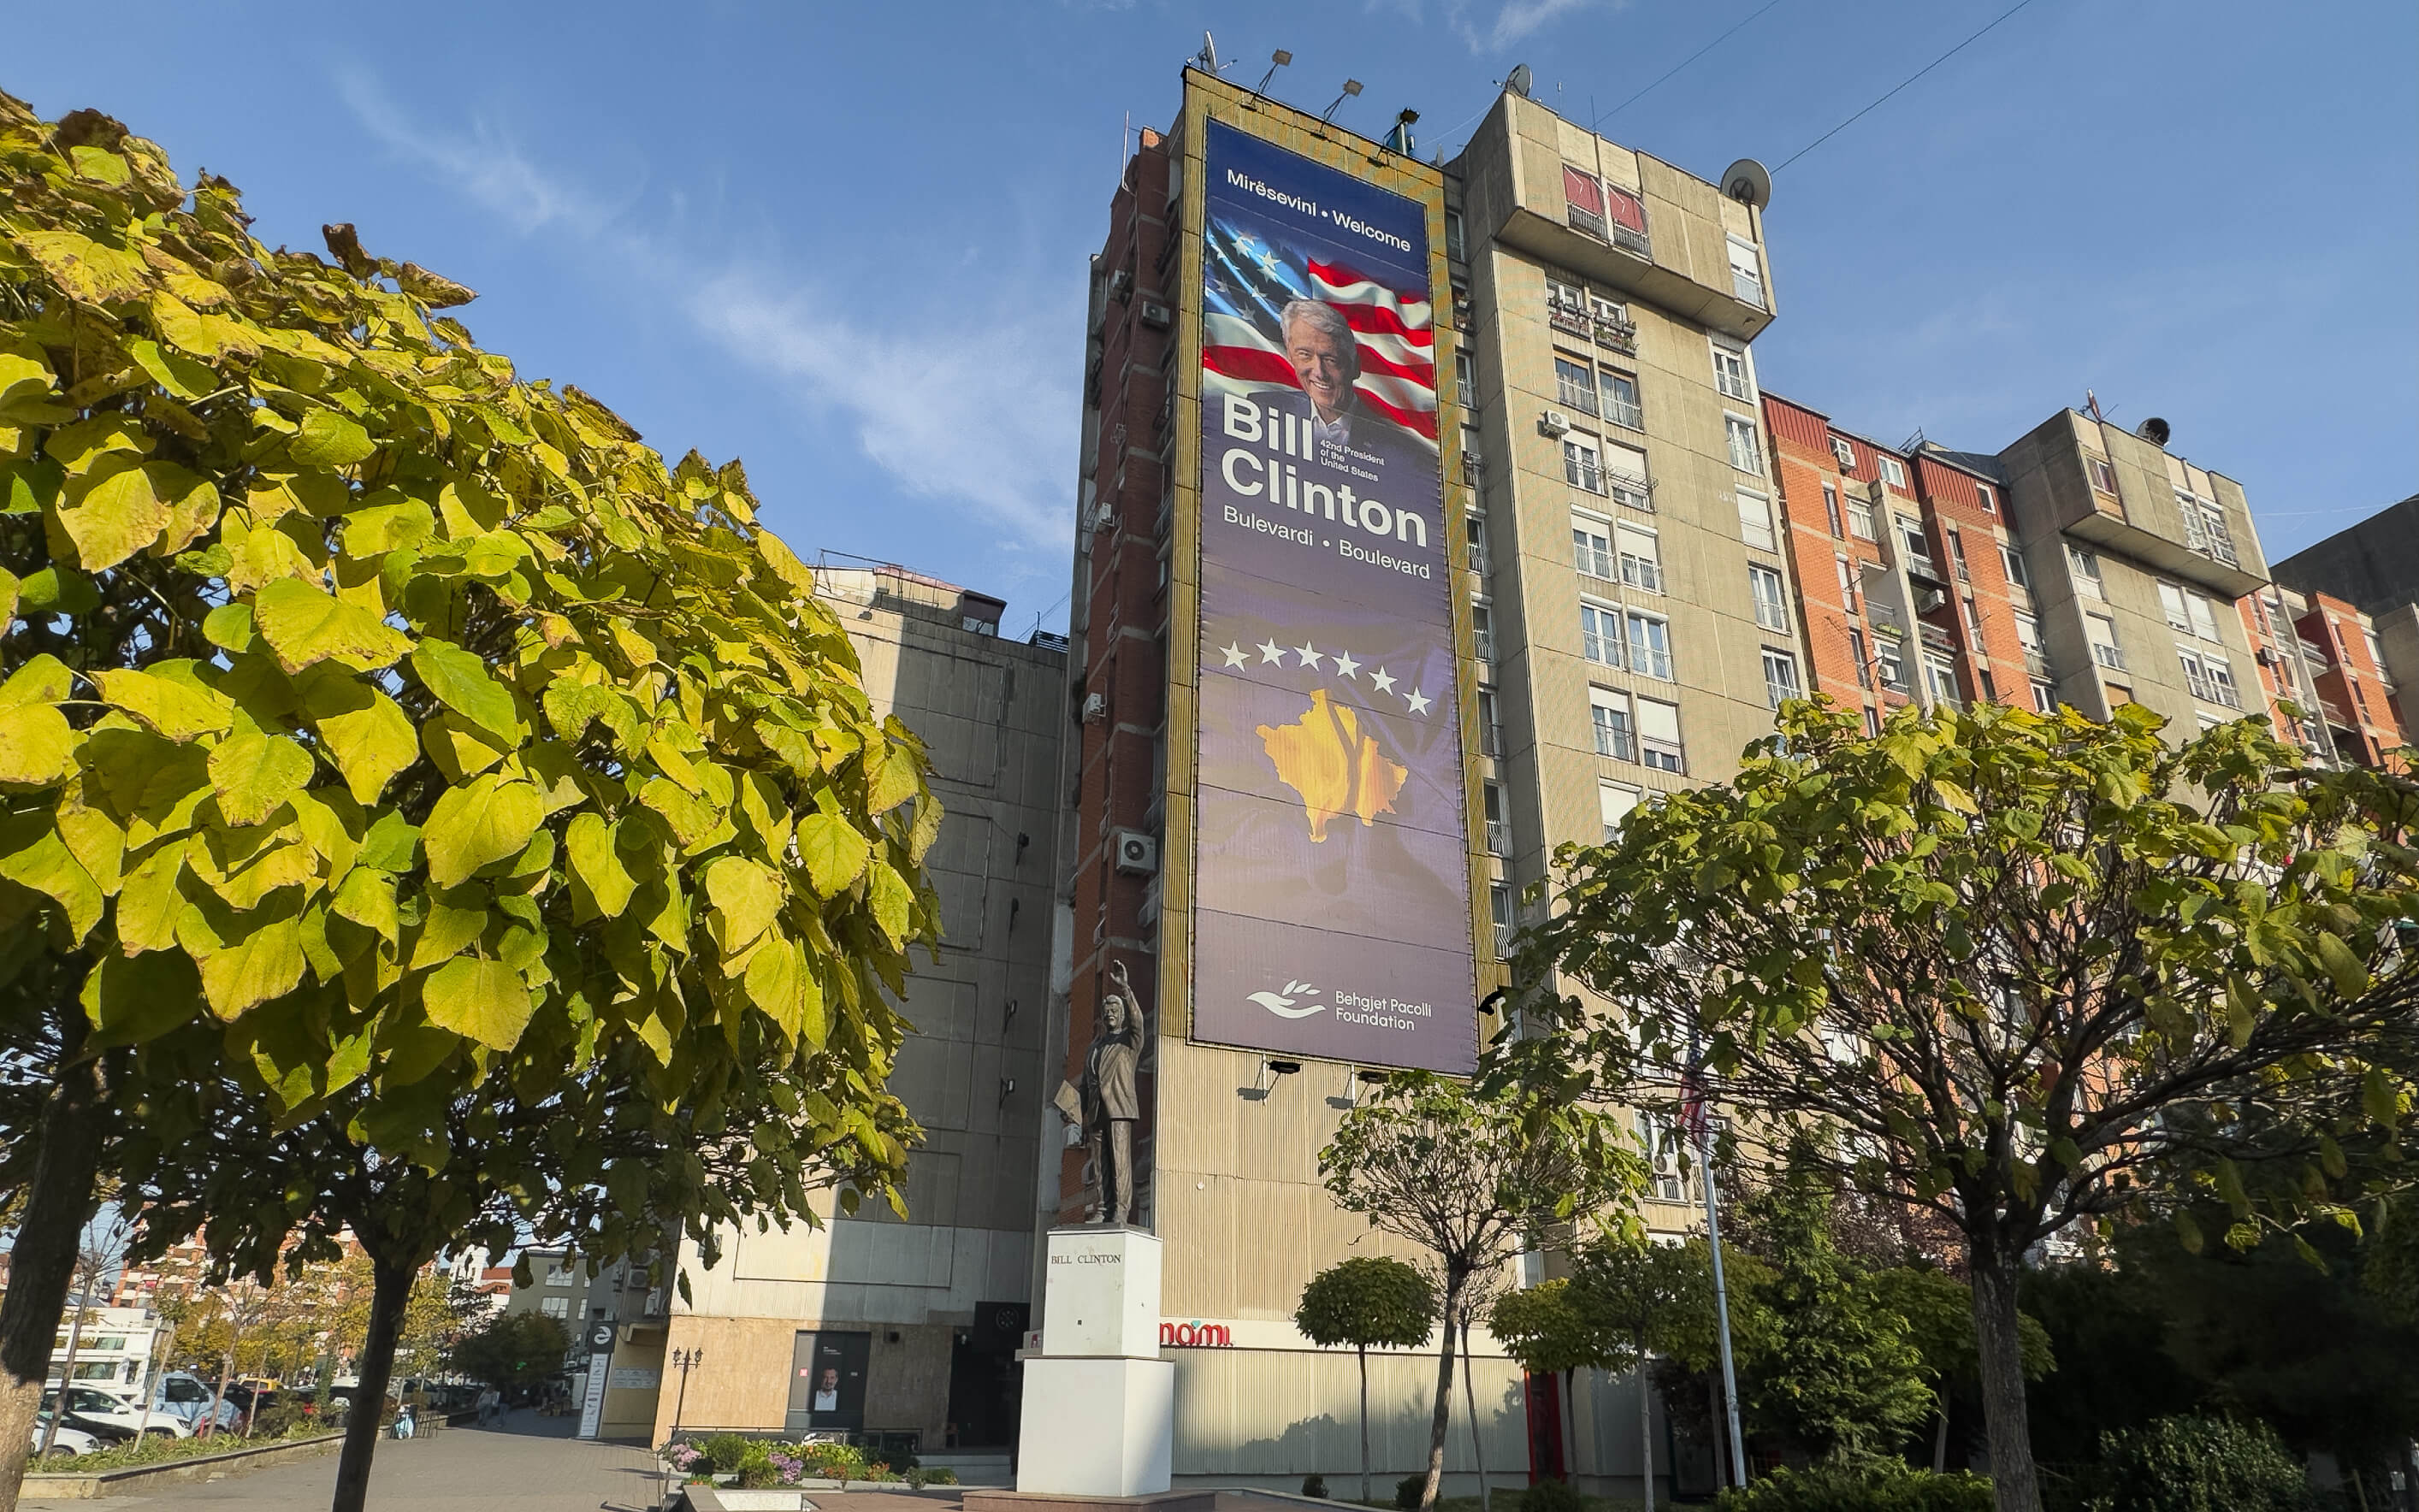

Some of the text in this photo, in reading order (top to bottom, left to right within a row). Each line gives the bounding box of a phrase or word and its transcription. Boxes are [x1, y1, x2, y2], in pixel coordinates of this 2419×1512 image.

[1227, 169, 1411, 252] Mirësevini Welcome
[1223, 393, 1313, 462] Bill
[1320, 440, 1385, 466] 42nd President
[1320, 448, 1346, 462] of the
[1320, 457, 1379, 482] United States
[1221, 448, 1427, 548] Clinton
[1224, 505, 1431, 580] Bulevardi Boulevard
[1335, 990, 1432, 1018] Behgjet Pacolli
[1335, 1007, 1415, 1031] Foundation
[1051, 1254, 1121, 1266] BILL CLINTON
